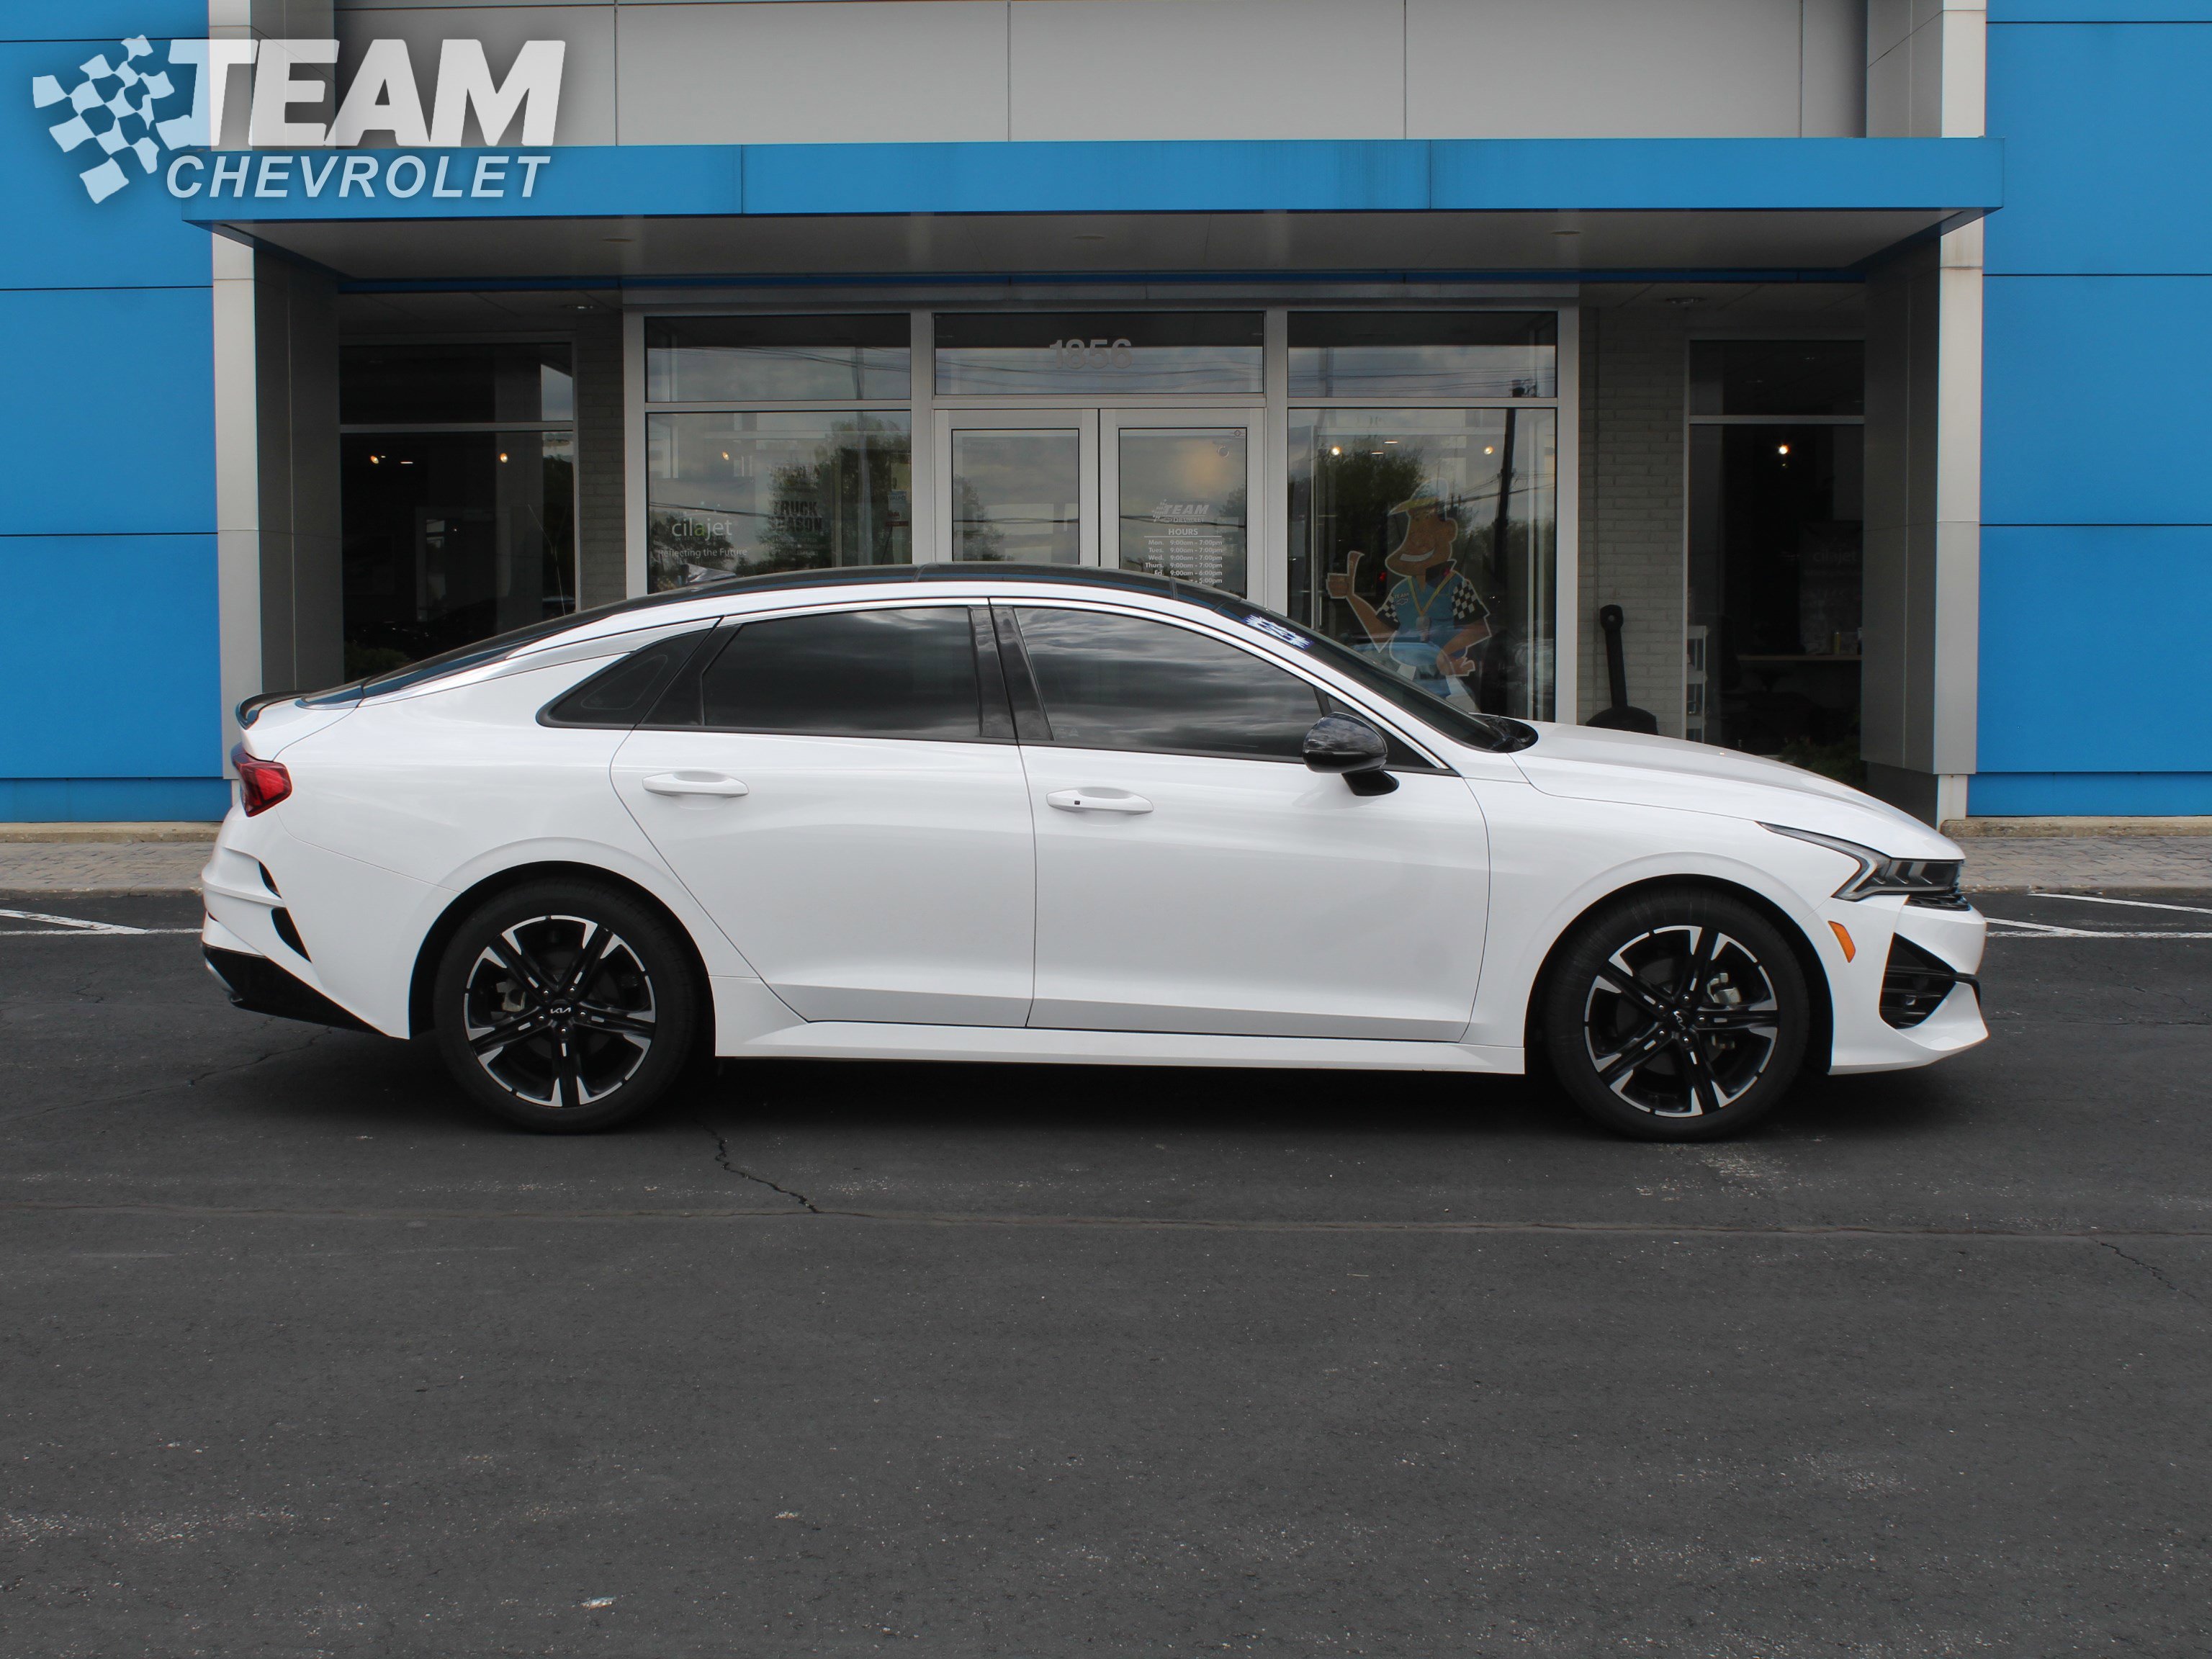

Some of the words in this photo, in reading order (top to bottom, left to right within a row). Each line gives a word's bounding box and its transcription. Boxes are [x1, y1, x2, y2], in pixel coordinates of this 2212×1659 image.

[1049, 338, 1133, 369] 1856
[773, 500, 818, 516] TRUCK
[1164, 504, 1210, 514] TEAM
[671, 517, 733, 541] cilajet
[658, 548, 701, 558] Reflecting
[703, 548, 719, 557] the
[719, 548, 748, 557] Future
